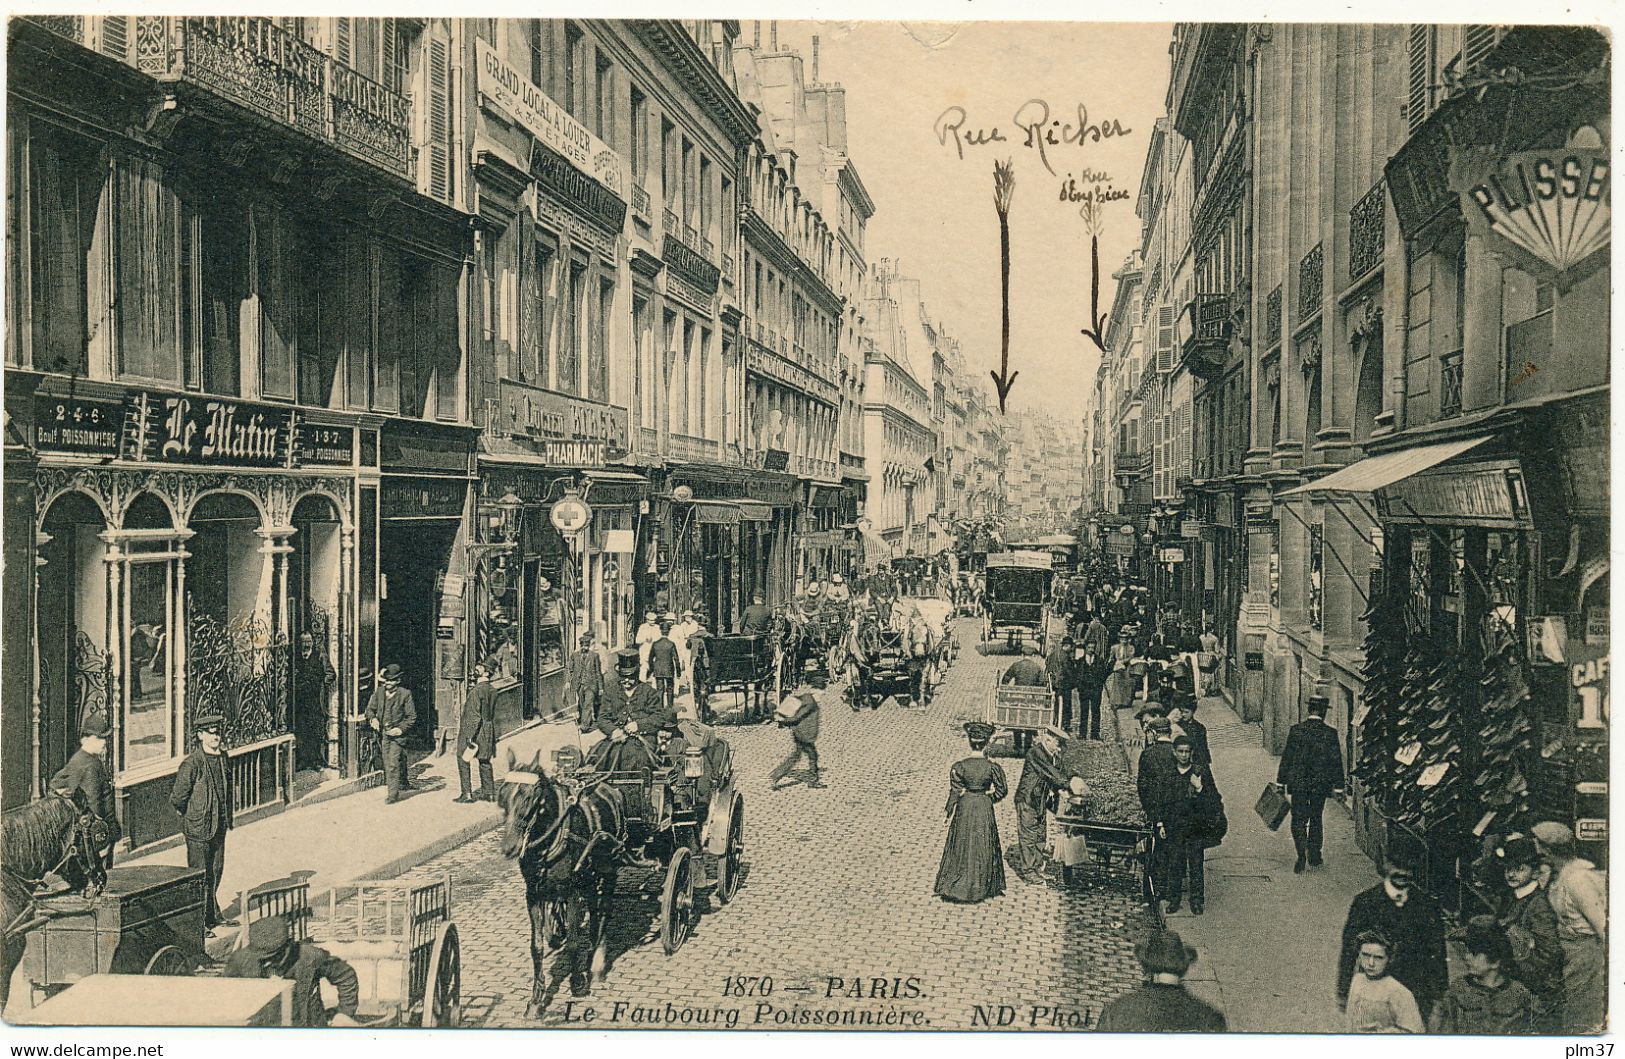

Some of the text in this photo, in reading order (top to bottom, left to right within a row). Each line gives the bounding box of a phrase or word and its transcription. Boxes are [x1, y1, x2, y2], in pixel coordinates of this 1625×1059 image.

[486, 52, 519, 96] GRAND
[522, 81, 551, 124] LOCAL
[563, 116, 591, 154] LOUER
[546, 128, 586, 164] ETAGES
[934, 105, 1007, 160] Rue
[1013, 98, 1132, 177] Richer
[1082, 167, 1113, 184] Rue
[163, 399, 278, 458] Le Matin
[546, 442, 605, 465] PHARMACIE
[1577, 687, 1609, 728] 1
